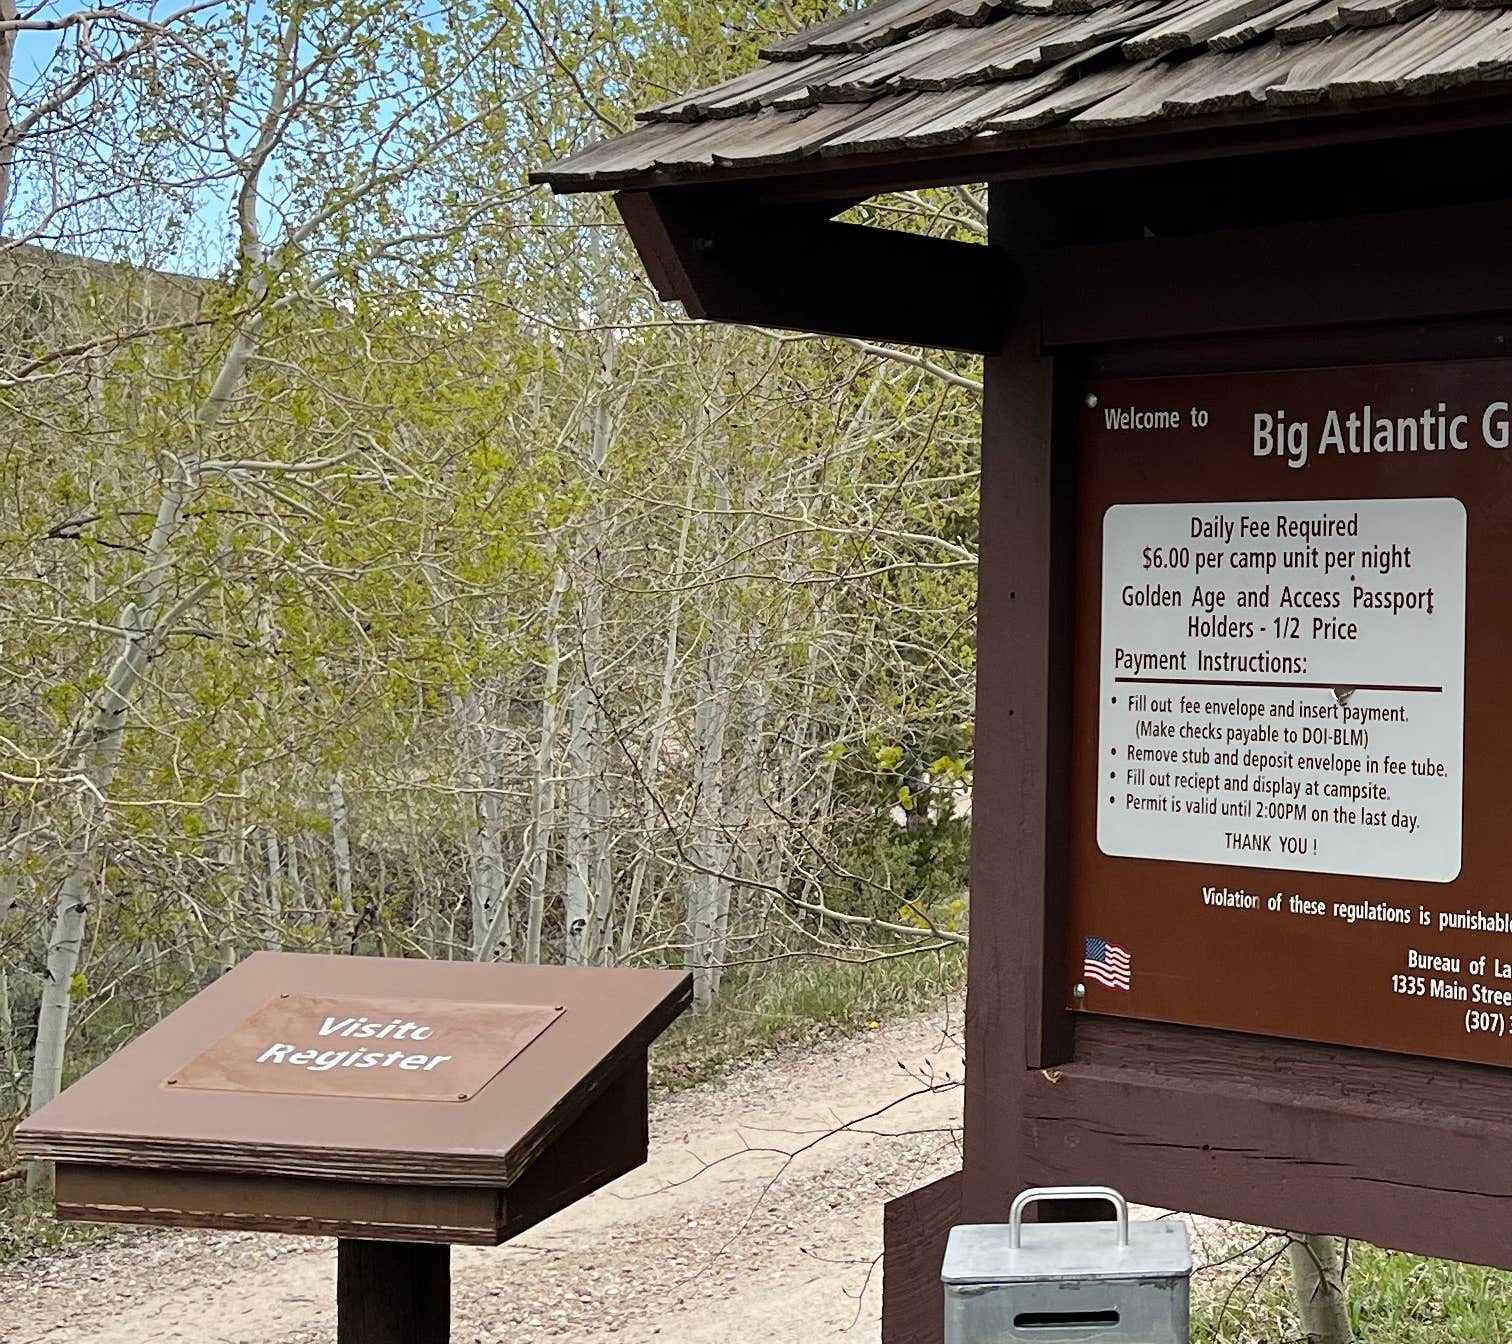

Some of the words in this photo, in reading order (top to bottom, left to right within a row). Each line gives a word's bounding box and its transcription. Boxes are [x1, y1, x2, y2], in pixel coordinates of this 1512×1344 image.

[1104, 406, 1180, 430] Welcome
[1190, 407, 1209, 428] to
[1253, 409, 1308, 469] Big
[1317, 402, 1468, 455] Atlantic
[1191, 514, 1235, 545] Daily
[1240, 515, 1270, 538] Fee
[1276, 512, 1358, 544] Required
[1142, 546, 1190, 571] $6.00
[1195, 551, 1225, 575] per
[1229, 551, 1277, 575] camp
[1283, 544, 1319, 569] unit
[1324, 551, 1356, 575] per
[1361, 543, 1411, 575] night
[1121, 583, 1182, 607] Golden
[1191, 585, 1226, 614] Age
[1237, 584, 1270, 608] and
[1279, 585, 1341, 609] Access
[1353, 585, 1435, 616] Passport
[1188, 614, 1254, 639] Holders
[1273, 616, 1300, 639] 1/2
[1312, 616, 1358, 640] Price
[1115, 647, 1187, 676] Payment
[1198, 649, 1307, 674] Instructions:
[1128, 694, 1147, 712] Fill
[1150, 697, 1173, 713] out
[1179, 695, 1201, 714] fee
[1204, 697, 1265, 721] envelope
[1269, 699, 1295, 718] and
[1299, 700, 1339, 720] insert
[1343, 705, 1409, 725] payment.
[1135, 719, 1175, 739] (Make
[1179, 721, 1223, 740] checks
[1226, 723, 1279, 746] payable
[1283, 727, 1298, 744] to
[1302, 727, 1369, 751] DOI-BLM)
[1127, 744, 1178, 763] Remove
[1181, 747, 1210, 765] stub
[1214, 748, 1239, 766] and
[1243, 749, 1294, 773] deposit
[1297, 753, 1361, 777] envelope
[1366, 755, 1379, 774] in
[1383, 755, 1407, 775] fee
[1411, 757, 1448, 778] tube.
[1126, 793, 1168, 812] Permit
[1171, 795, 1182, 813] is
[1185, 797, 1217, 815] valid
[1221, 799, 1252, 817] until
[1255, 801, 1307, 821] 2:00PM
[1311, 809, 1329, 823] on
[1333, 805, 1357, 825] the
[1361, 806, 1387, 827] last
[1391, 809, 1420, 834] day.
[1224, 832, 1272, 852] THANK
[1279, 835, 1308, 855] YOU
[1202, 887, 1260, 909] Violation
[1267, 892, 1283, 911] of
[1289, 894, 1326, 915] these
[1333, 900, 1411, 924] regulations
[1419, 905, 1431, 926] is
[1408, 949, 1461, 973] Bureau
[1469, 955, 1487, 976] of
[1391, 974, 1426, 996] 1335
[1430, 978, 1468, 1001] Main
[1465, 1009, 1505, 1037] (307)
[256, 1043, 453, 1071] Register
